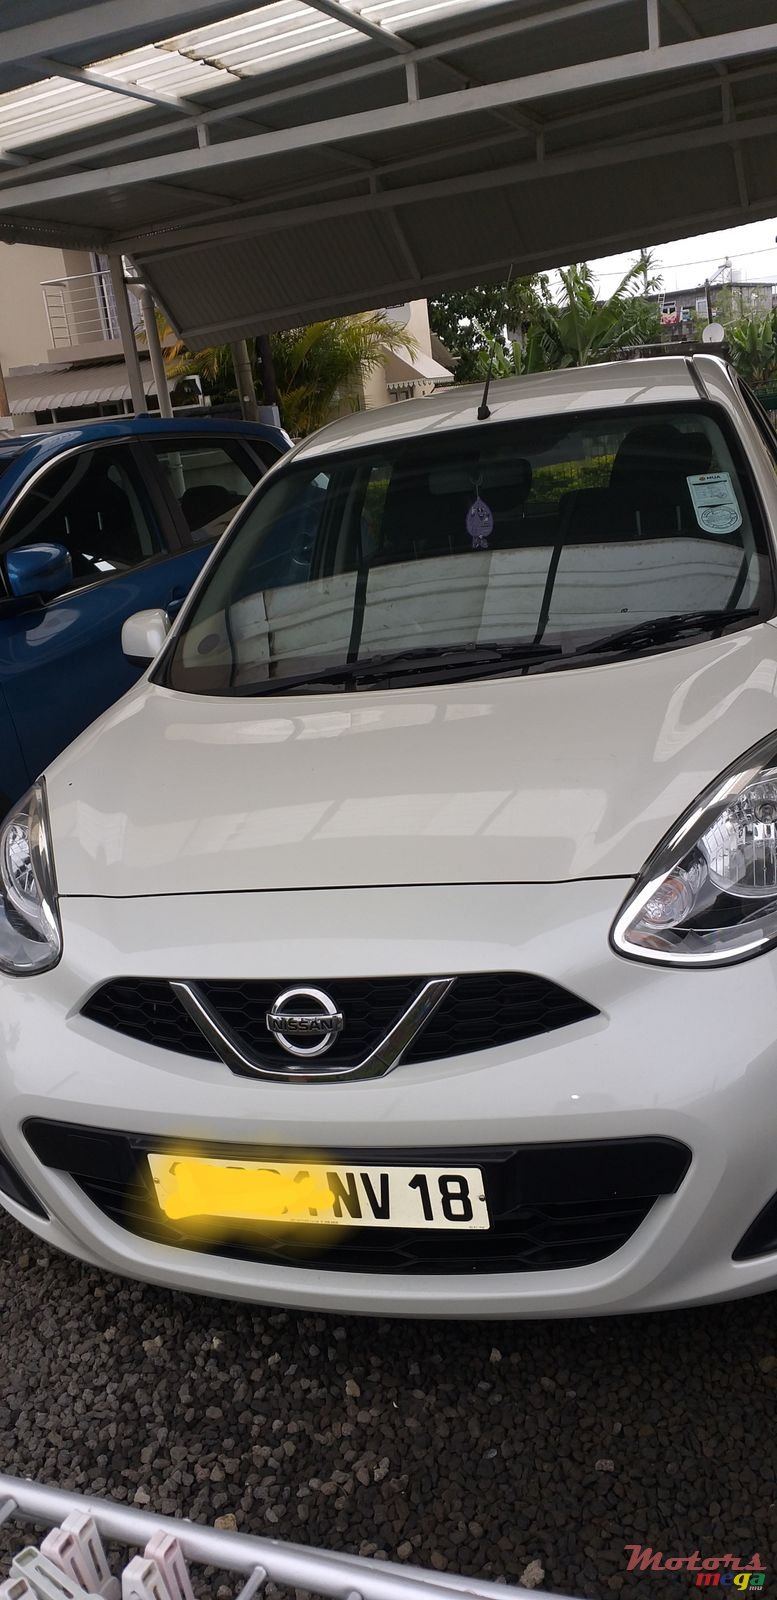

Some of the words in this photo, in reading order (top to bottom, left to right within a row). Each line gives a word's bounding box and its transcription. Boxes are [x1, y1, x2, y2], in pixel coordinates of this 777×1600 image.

[272, 1017, 334, 1032] NISSAN
[327, 1172, 390, 1219] NV
[409, 1174, 473, 1222] 18
